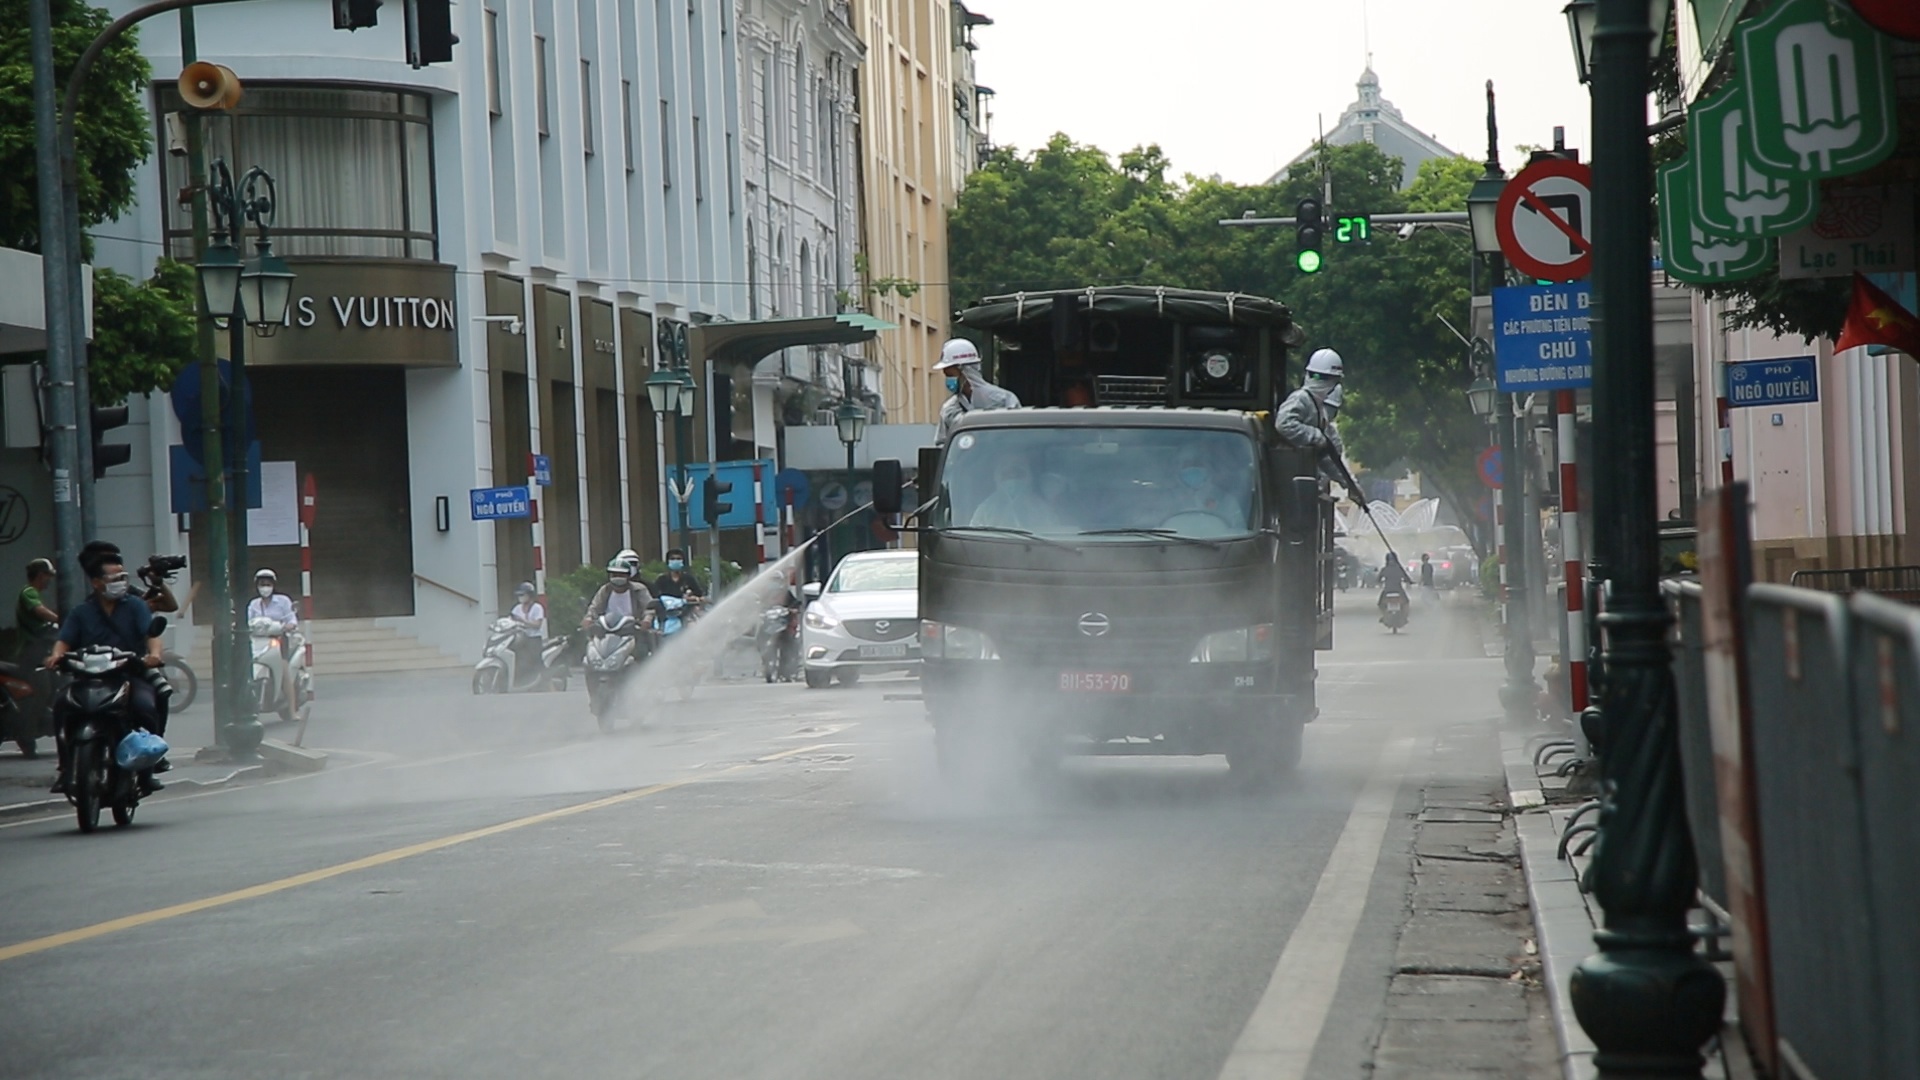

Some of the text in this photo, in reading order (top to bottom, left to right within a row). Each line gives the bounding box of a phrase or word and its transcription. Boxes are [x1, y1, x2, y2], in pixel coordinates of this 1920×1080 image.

[1337, 217, 1366, 242] 27
[1800, 242, 1896, 272] Lạc Thái
[332, 296, 455, 329] VUITTON
[1530, 290, 1590, 312] ĐÈN Đ
[1539, 337, 1576, 359] CHÚ
[1735, 376, 1809, 400] NGÔ QUYỀN
